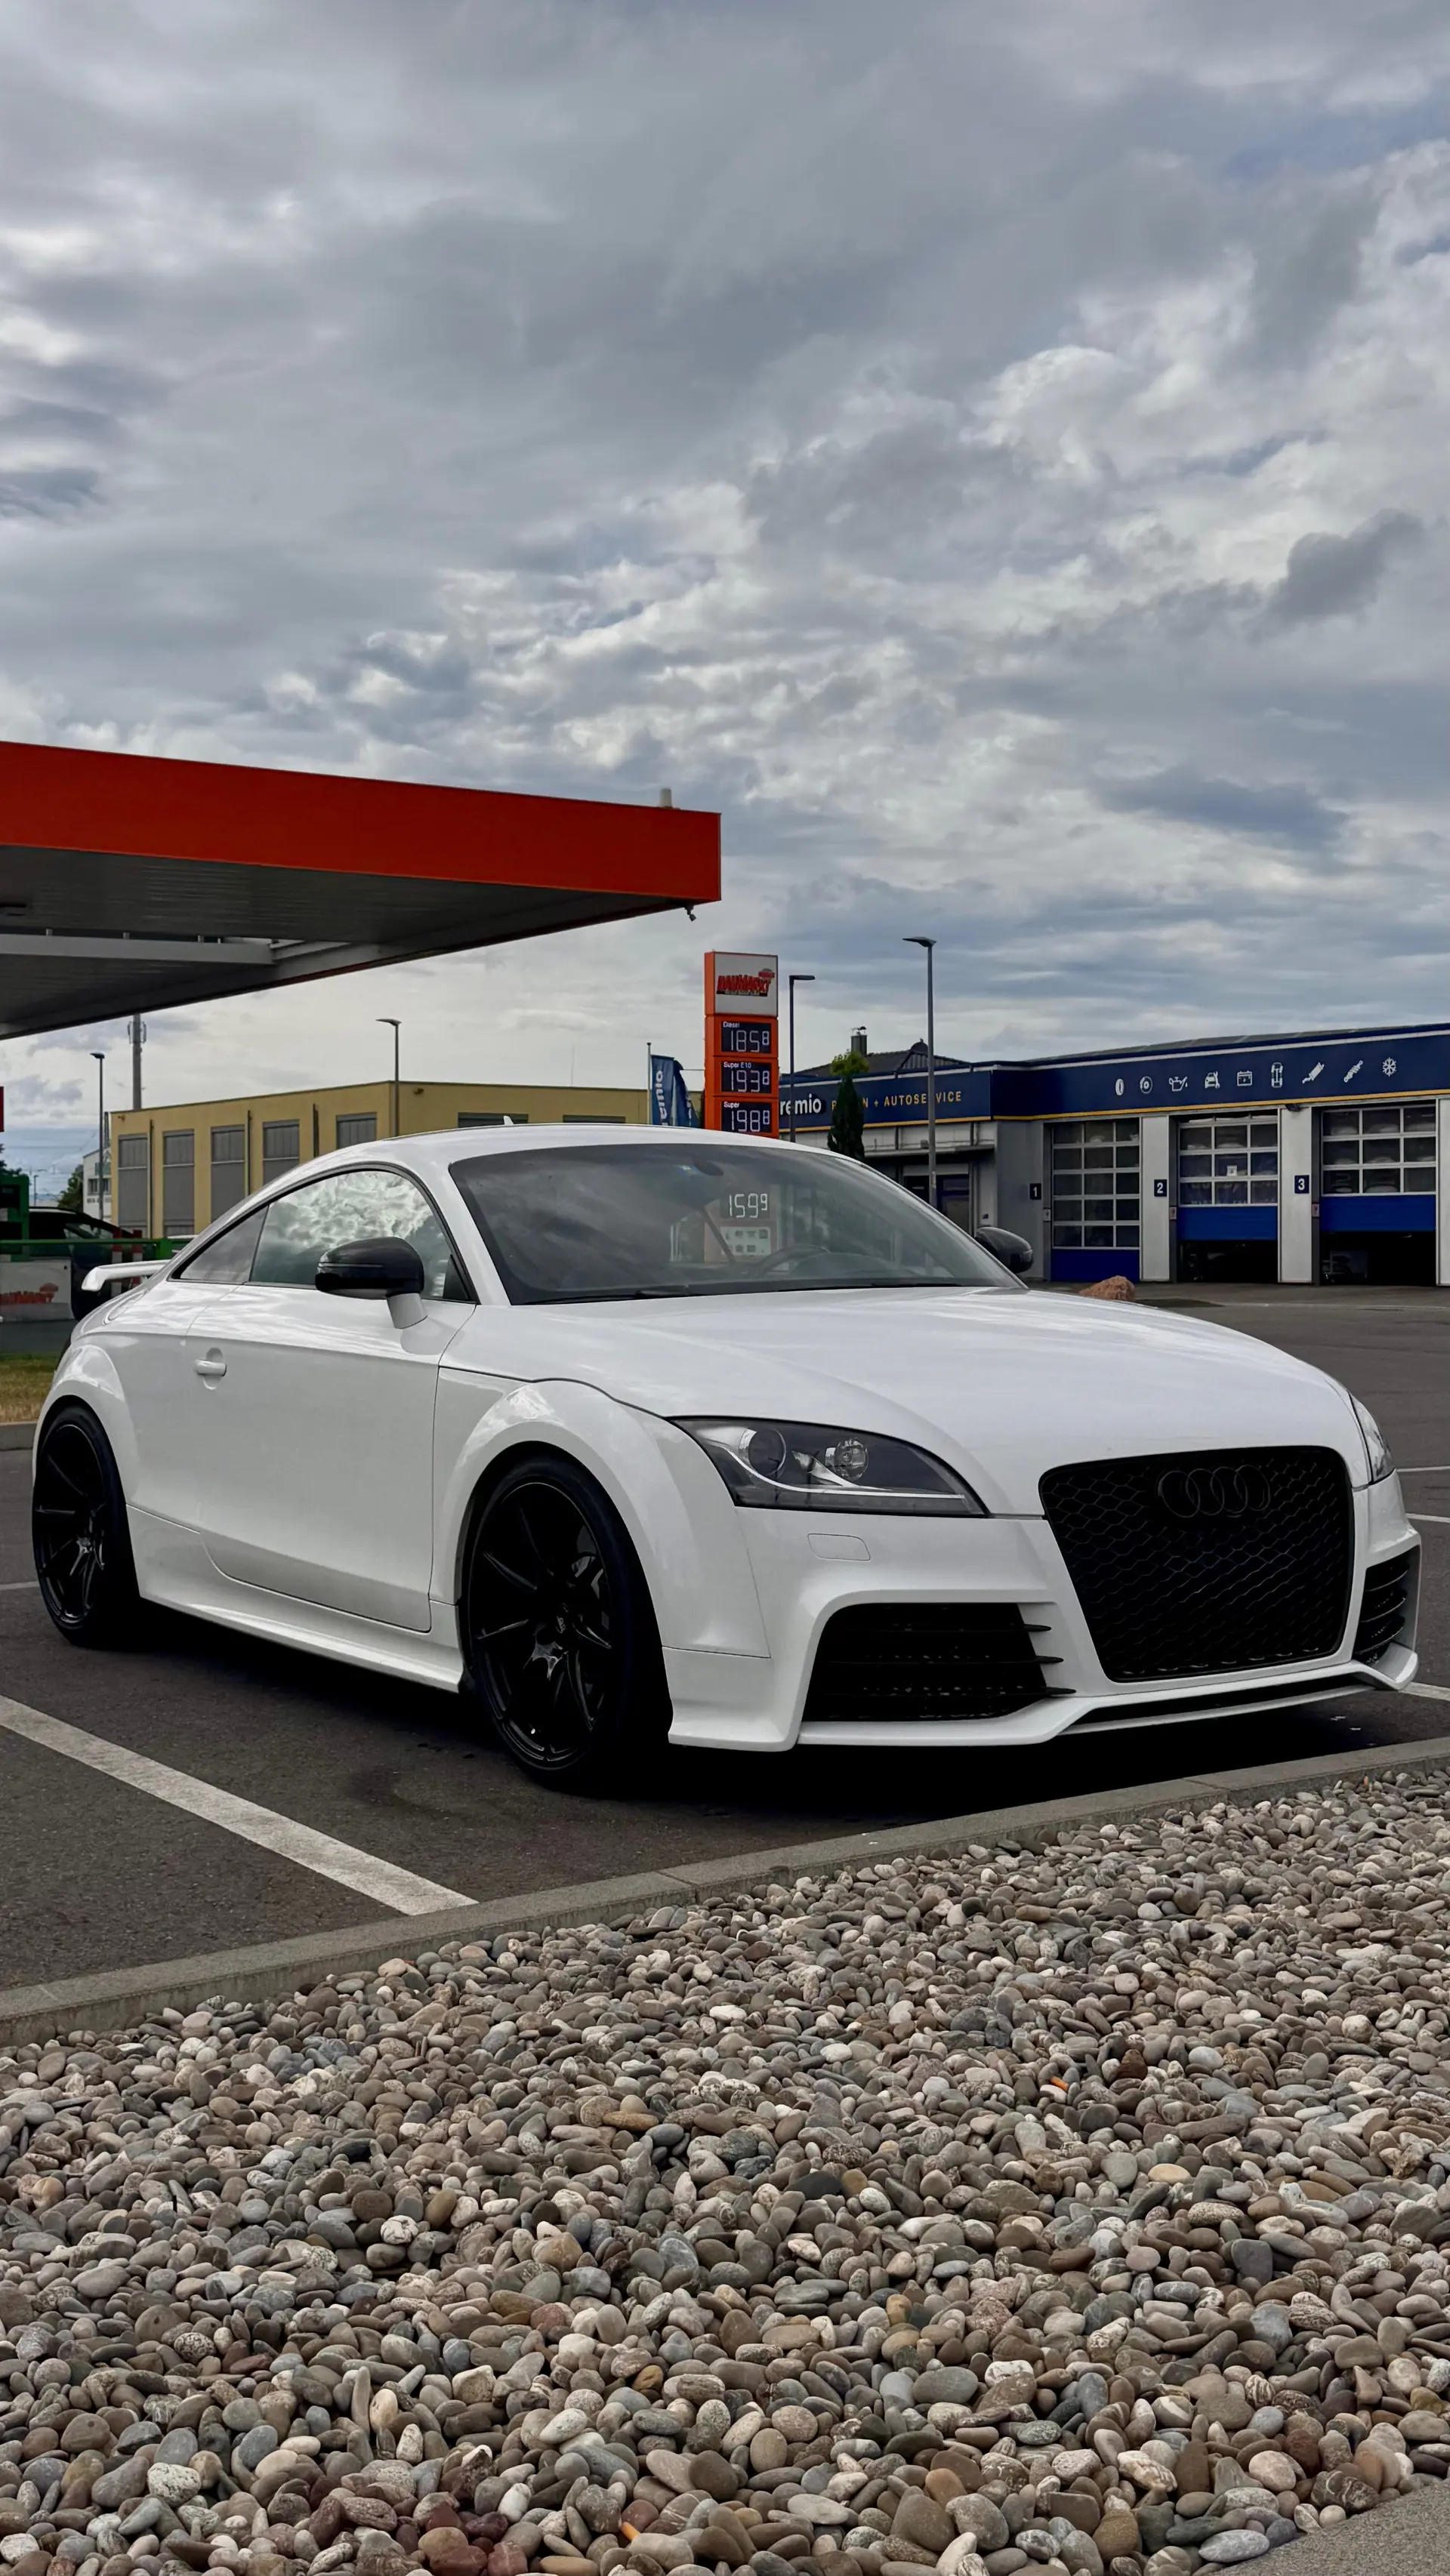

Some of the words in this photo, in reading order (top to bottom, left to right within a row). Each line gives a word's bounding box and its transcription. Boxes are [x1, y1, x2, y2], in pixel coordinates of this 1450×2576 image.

[723, 1061, 739, 1069] Super
[723, 1101, 740, 1109] Super
[779, 1092, 822, 1115] remio
[884, 1090, 962, 1108] AUTOSEVICE
[1156, 1182, 1164, 1194] 2
[1297, 1178, 1305, 1191] 3
[1032, 1186, 1038, 1197] 1
